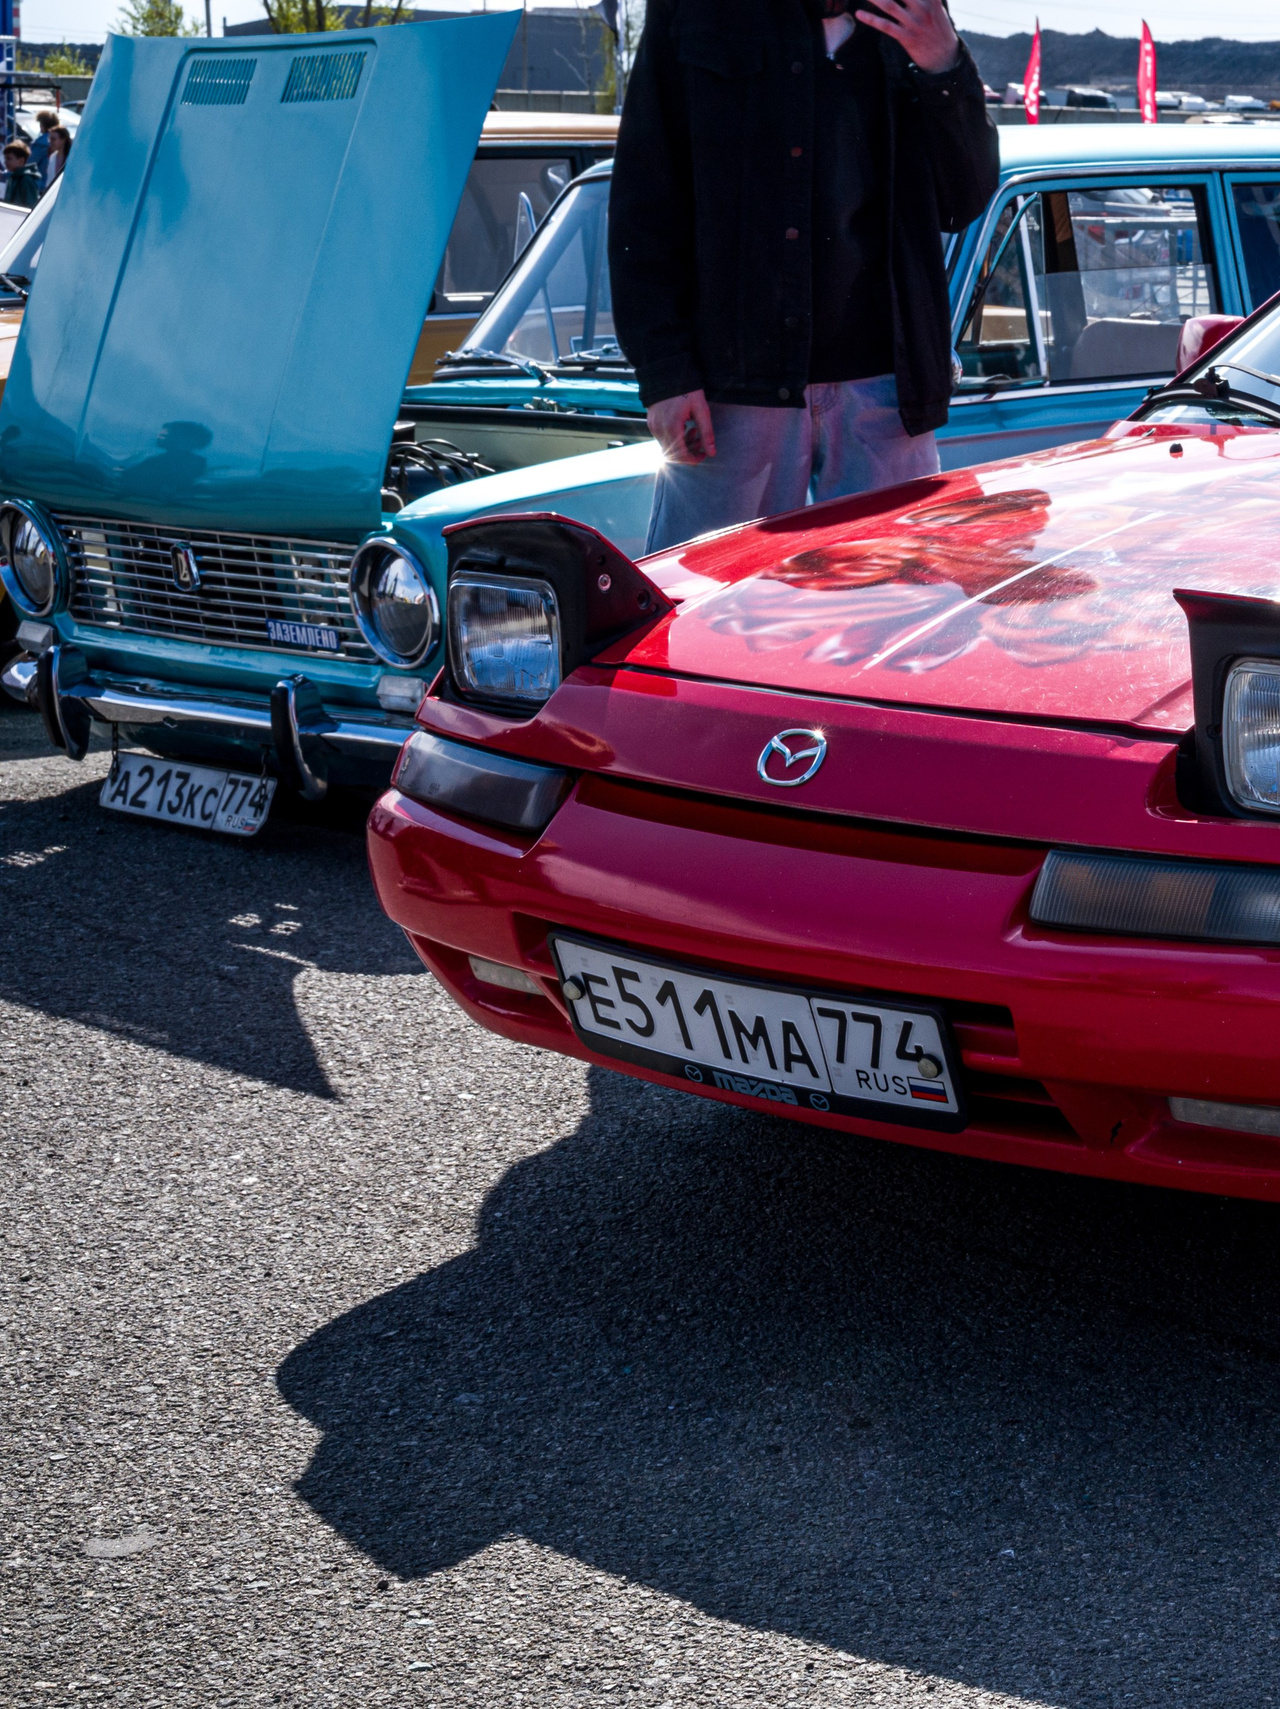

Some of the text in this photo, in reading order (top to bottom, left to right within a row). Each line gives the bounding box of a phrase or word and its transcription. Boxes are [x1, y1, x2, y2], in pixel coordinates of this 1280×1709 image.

[267, 621, 338, 650] ЗАЗЕМЛЕНО
[110, 764, 268, 821] А213КС 774
[225, 815, 245, 830] RUS
[581, 965, 926, 1079] Е511МА 774
[855, 1069, 907, 1096] RUS
